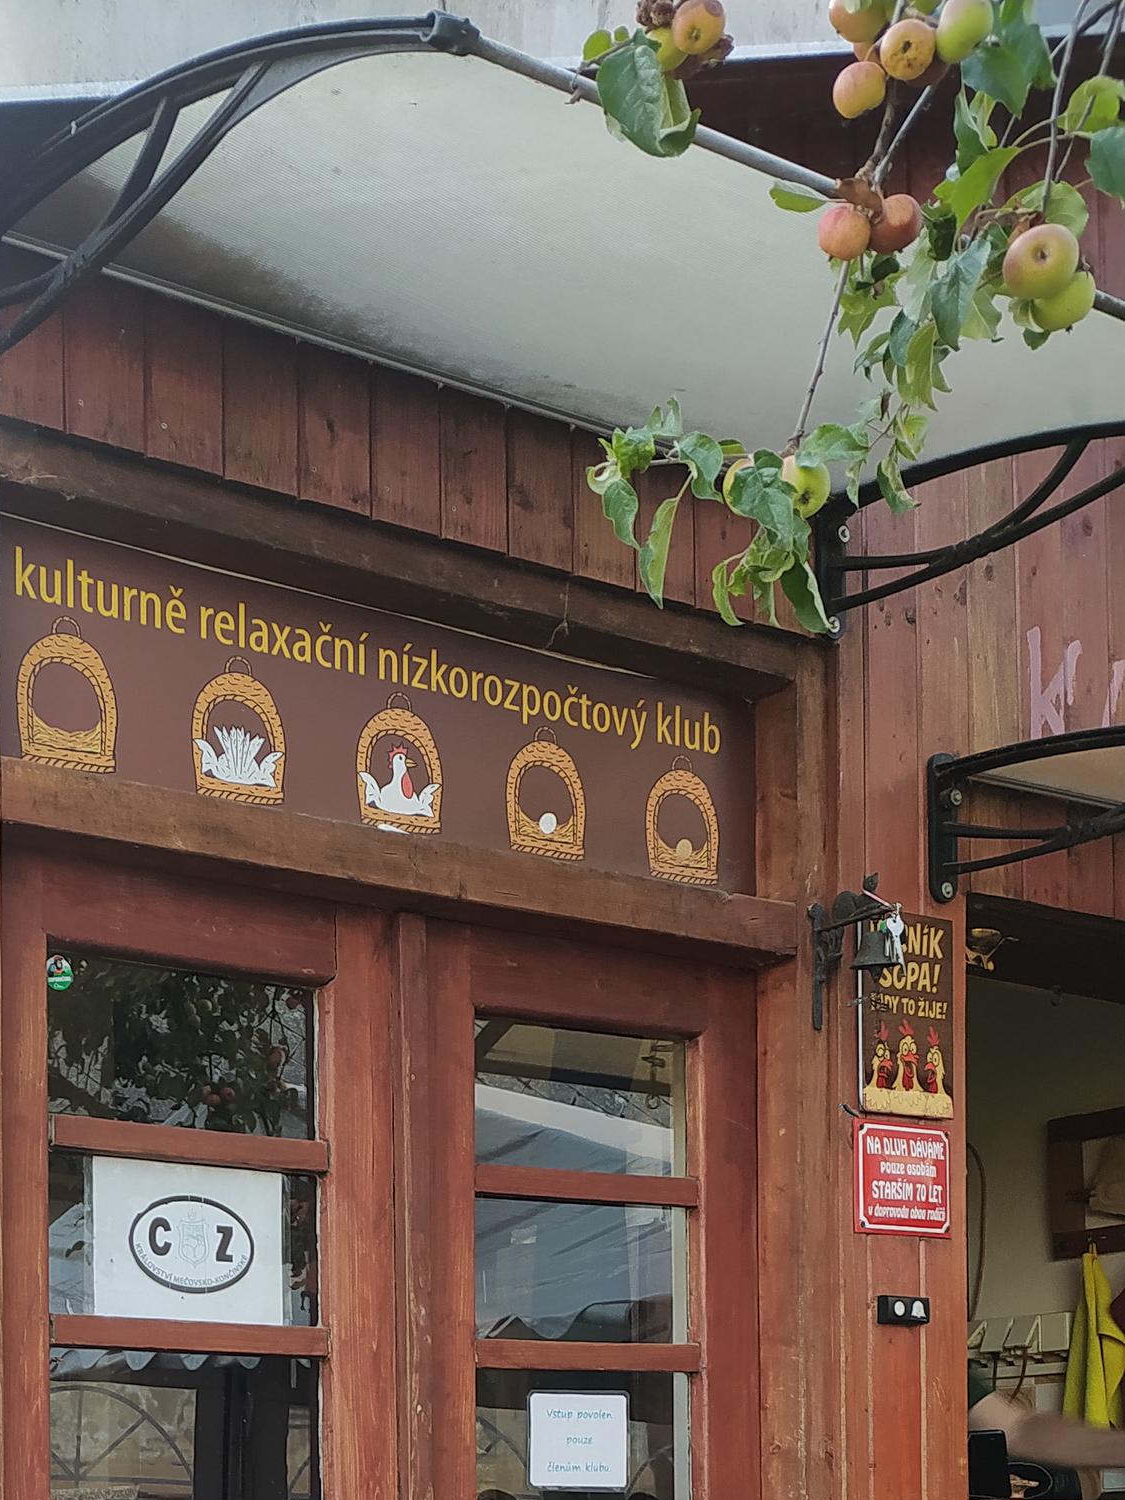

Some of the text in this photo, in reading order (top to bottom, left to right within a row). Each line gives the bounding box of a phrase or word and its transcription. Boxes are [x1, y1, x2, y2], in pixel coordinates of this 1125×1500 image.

[14, 546, 722, 755] kulturně relaxační nízkorozpočtový klub
[902, 998, 915, 1016] TO
[918, 998, 948, 1020] ŽIJE!
[867, 1135, 945, 1160] NA DLUH DÁVÁME
[907, 1163, 937, 1178] osobám
[872, 1178, 943, 1204] STARŠÍM 70 LET
[868, 1206, 873, 1215] v
[135, 1242, 173, 1281] KRÁLOVSTVÍ
[546, 1408, 612, 1420] Vstup povolen
[566, 1436, 593, 1446] pouze
[546, 1460, 581, 1473] členům
